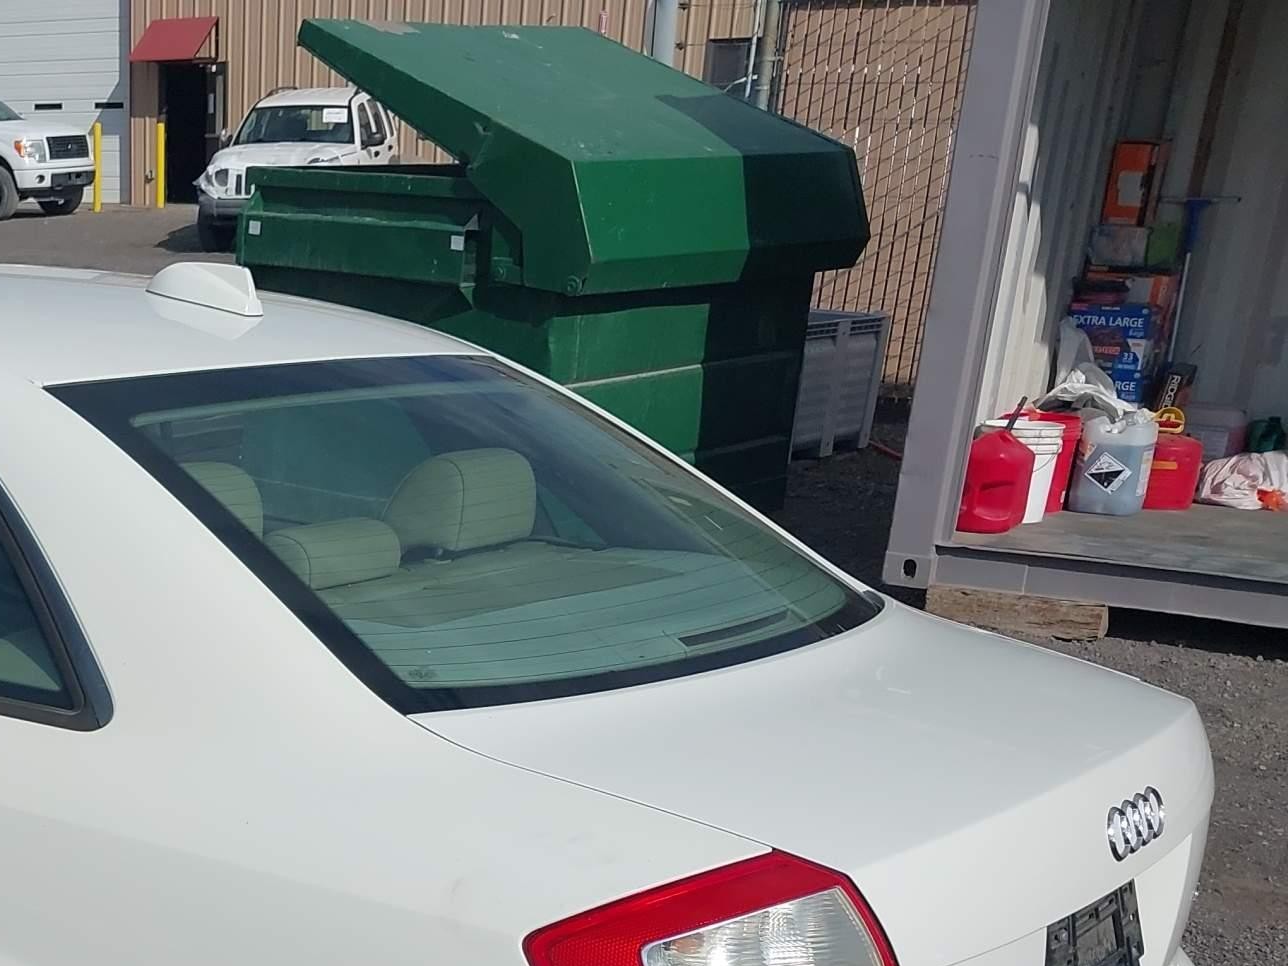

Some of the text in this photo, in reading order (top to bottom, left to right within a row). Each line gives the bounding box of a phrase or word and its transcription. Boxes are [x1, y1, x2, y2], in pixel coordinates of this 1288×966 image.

[1072, 314, 1145, 328] EXTRA LARGE
[1114, 381, 1137, 391] RGE
